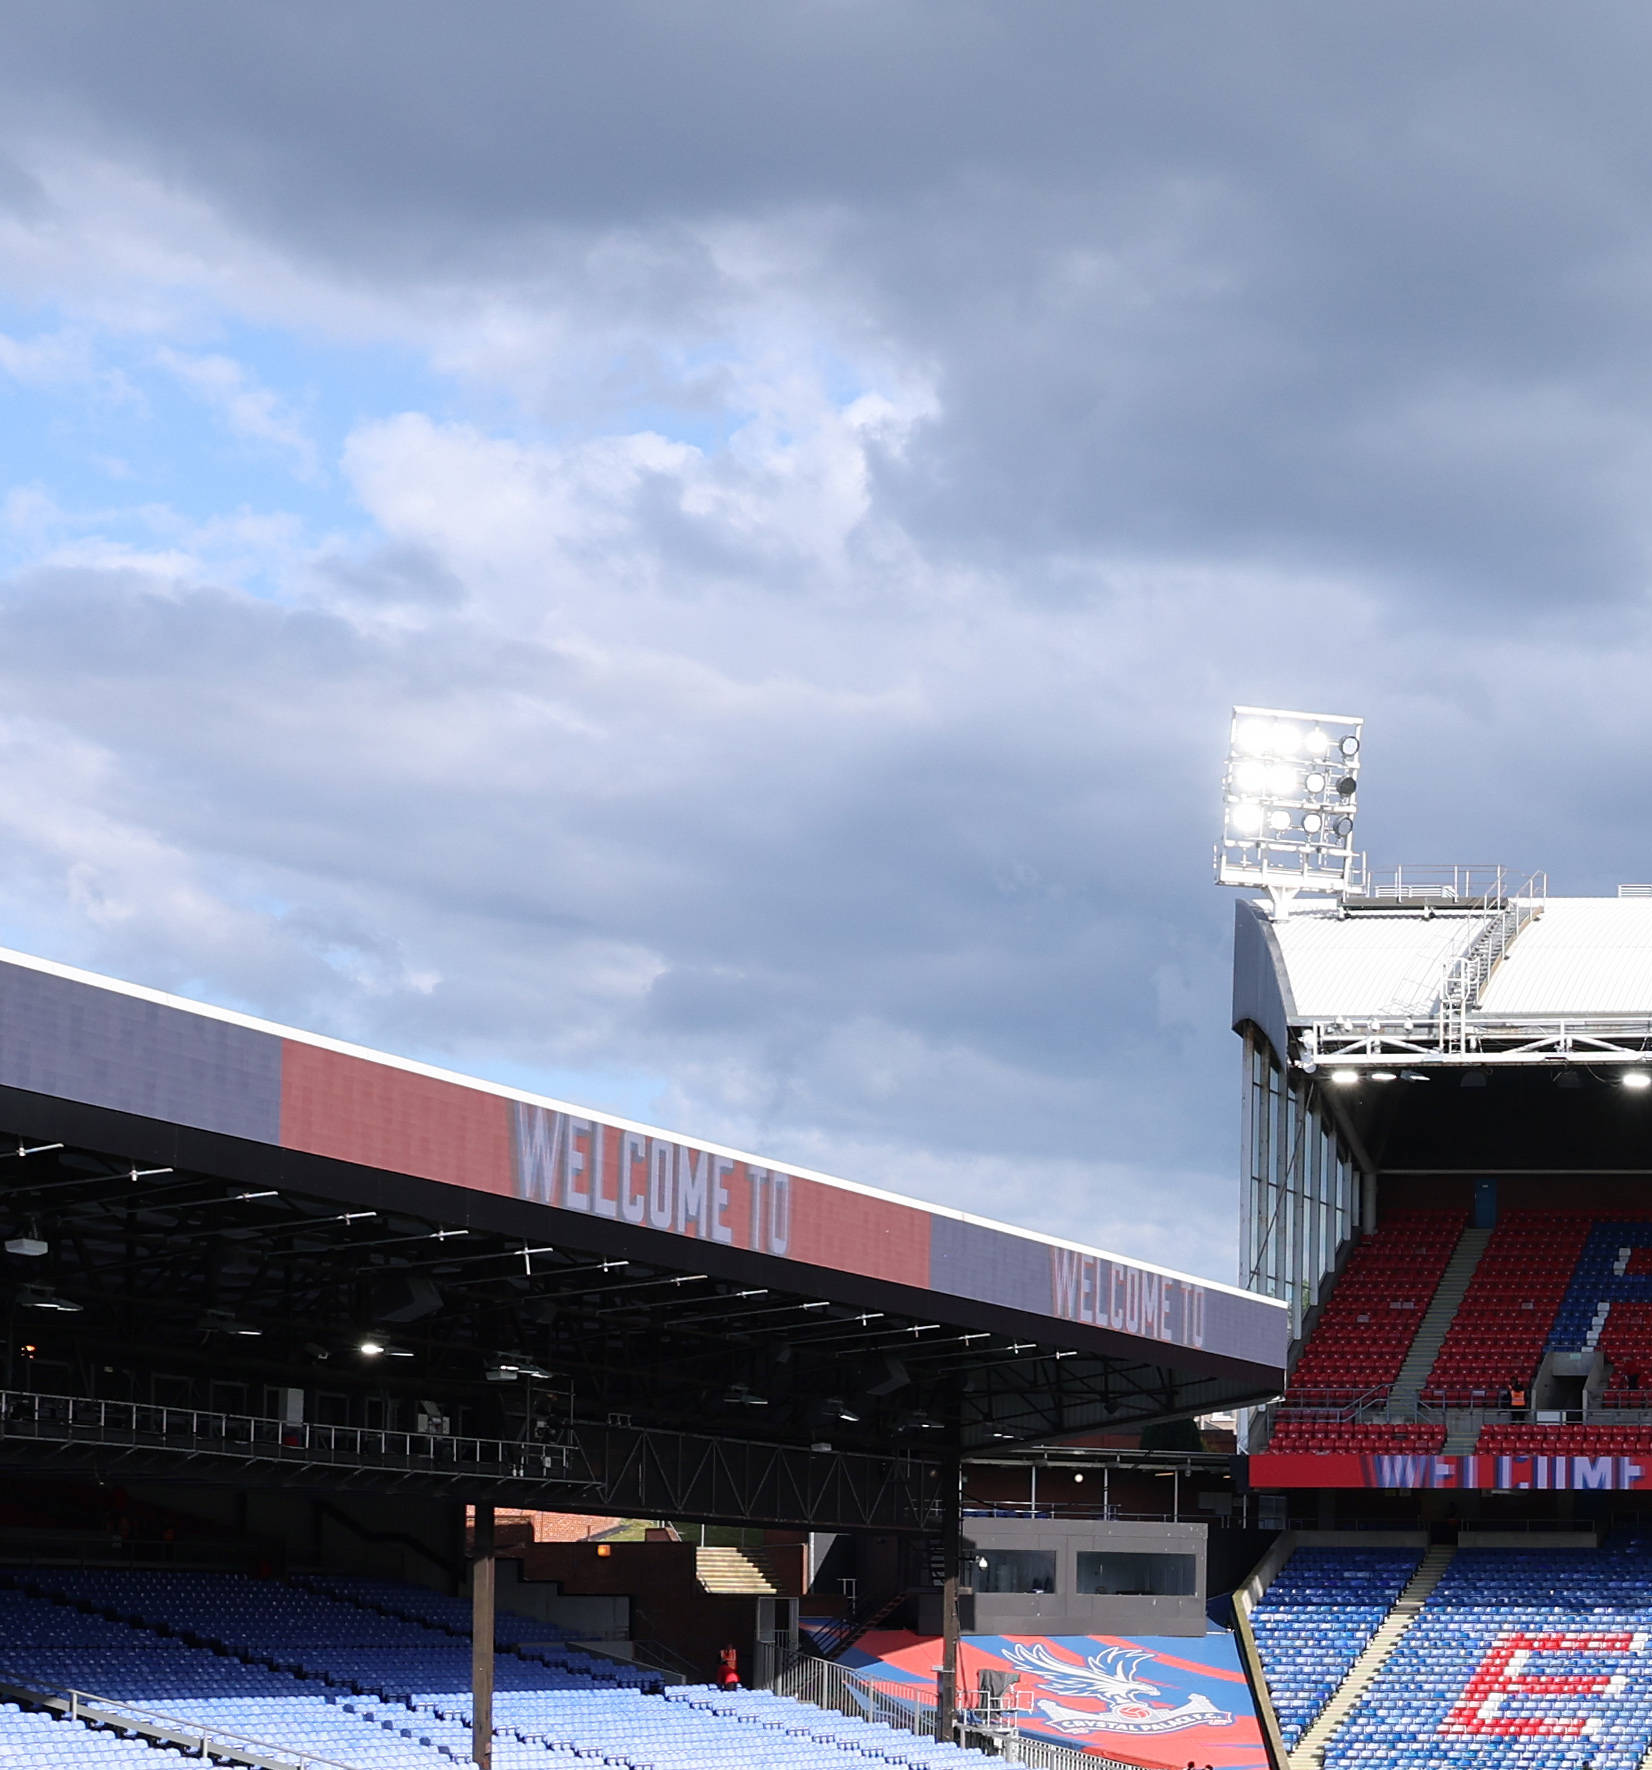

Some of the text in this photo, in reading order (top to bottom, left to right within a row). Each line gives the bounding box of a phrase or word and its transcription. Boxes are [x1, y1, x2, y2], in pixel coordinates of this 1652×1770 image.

[514, 1100, 790, 1254] WELCOME TO
[1051, 1246, 1206, 1347] WELCOME TO
[1064, 1718, 1140, 1732] CRYSTAL
[1142, 1714, 1196, 1732] PALACE
